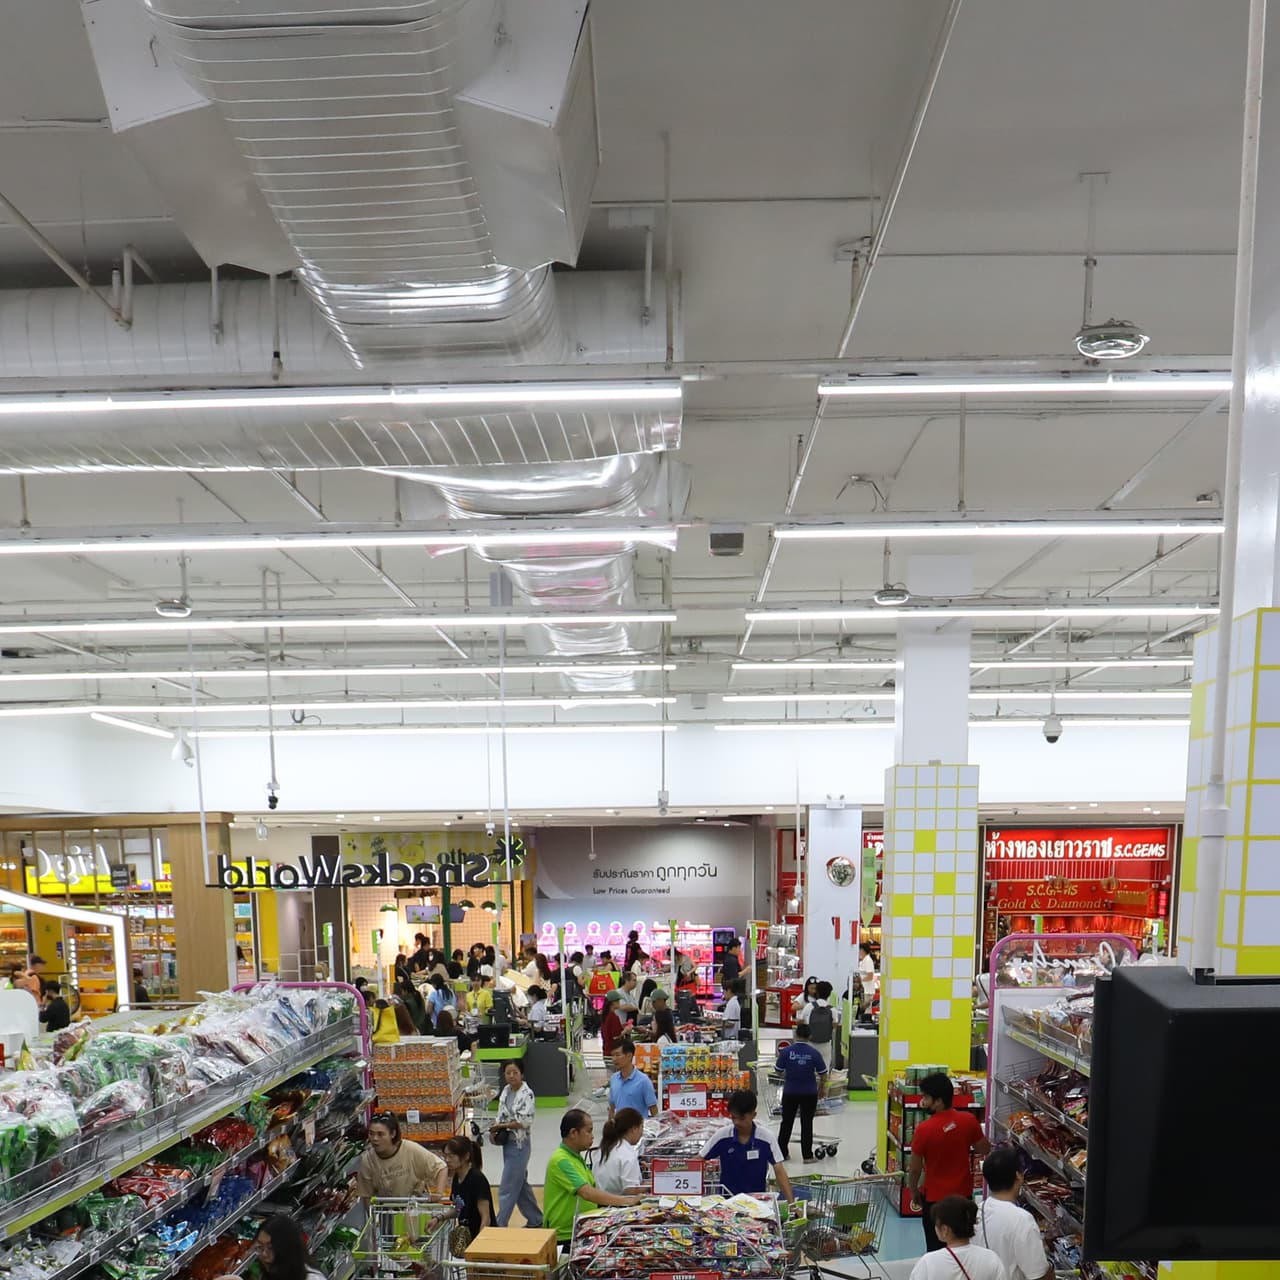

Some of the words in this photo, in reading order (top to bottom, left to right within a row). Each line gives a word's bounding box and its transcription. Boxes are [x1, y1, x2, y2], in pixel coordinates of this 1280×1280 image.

[985, 831, 1114, 859] ห้างทองเยาวราช
[1114, 843, 1166, 858] S.C.GEMS
[656, 861, 718, 883] ถูกทุกวัน
[592, 887, 607, 895] Low
[608, 886, 629, 895] Prices
[630, 885, 671, 895] Guaranteed
[679, 1097, 698, 1107] 455
[675, 1178, 689, 1190] 25
